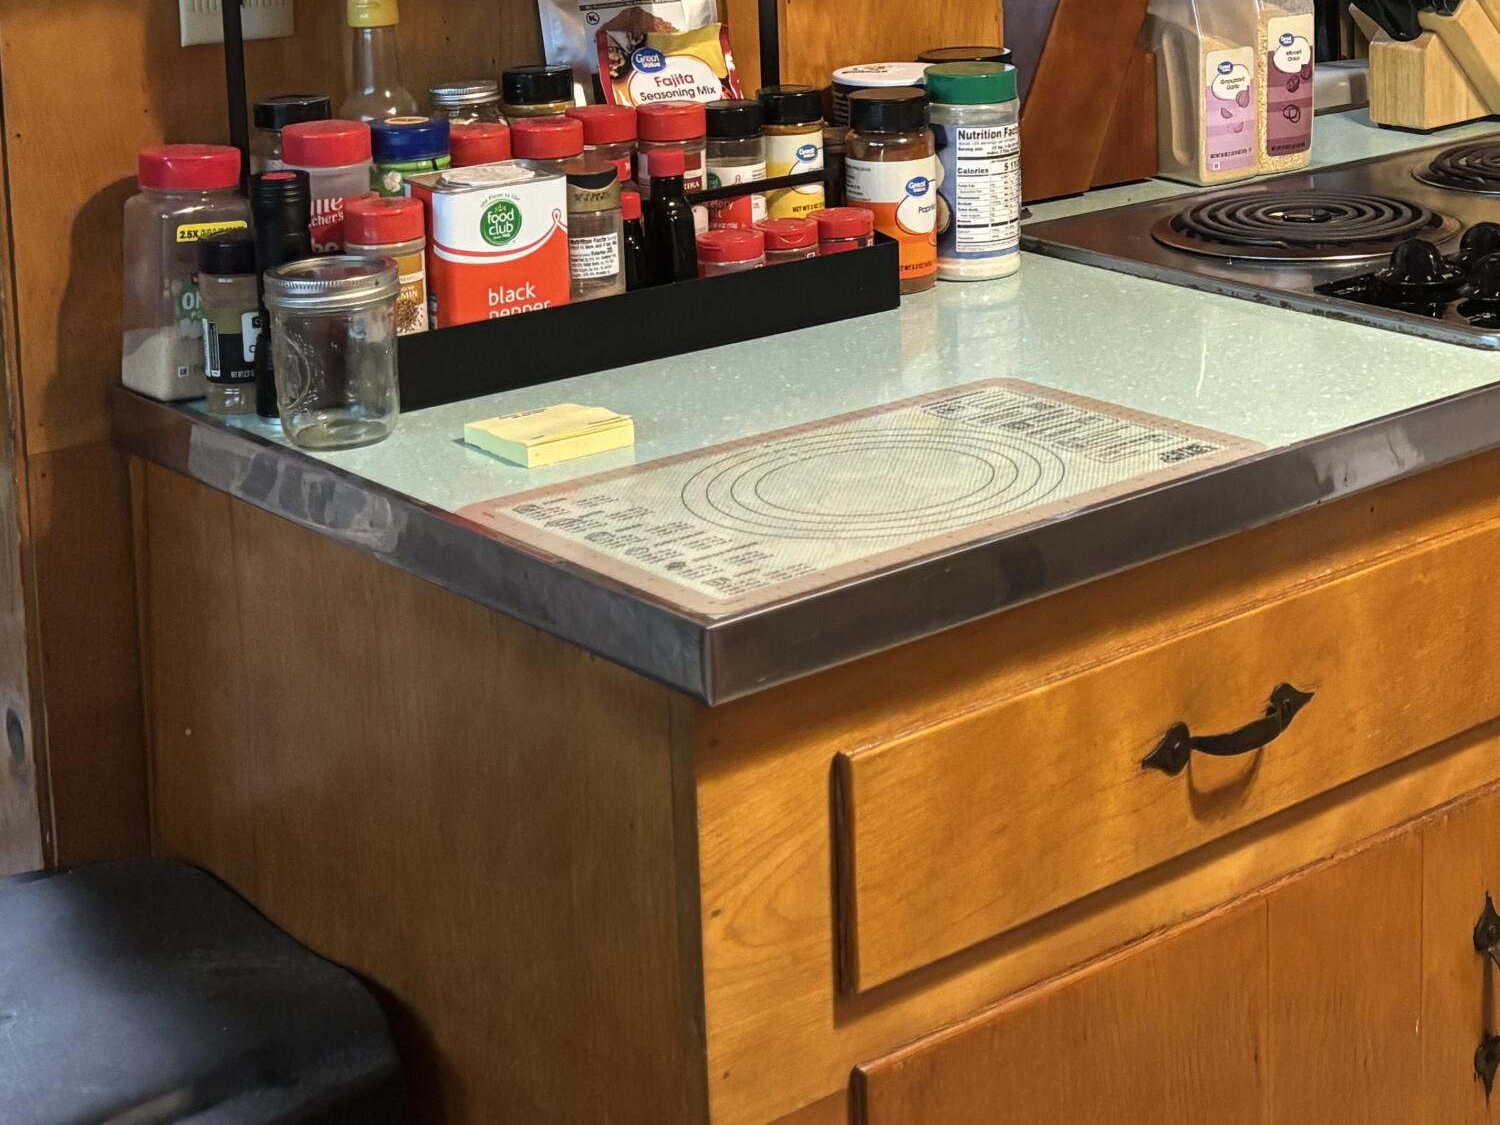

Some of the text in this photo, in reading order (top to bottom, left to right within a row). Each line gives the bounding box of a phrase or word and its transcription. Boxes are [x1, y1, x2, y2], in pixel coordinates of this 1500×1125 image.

[635, 53, 660, 63] Great
[654, 73, 695, 88] Fajita
[639, 85, 717, 102] Seasoning Mix
[958, 129, 1002, 141] Nutrition
[957, 166, 990, 175] Calories
[310, 210, 345, 227] cher's
[487, 207, 515, 225] food
[179, 229, 199, 239] 2.5X
[488, 220, 514, 236] club
[400, 290, 418, 300] MIN
[488, 280, 537, 307] black
